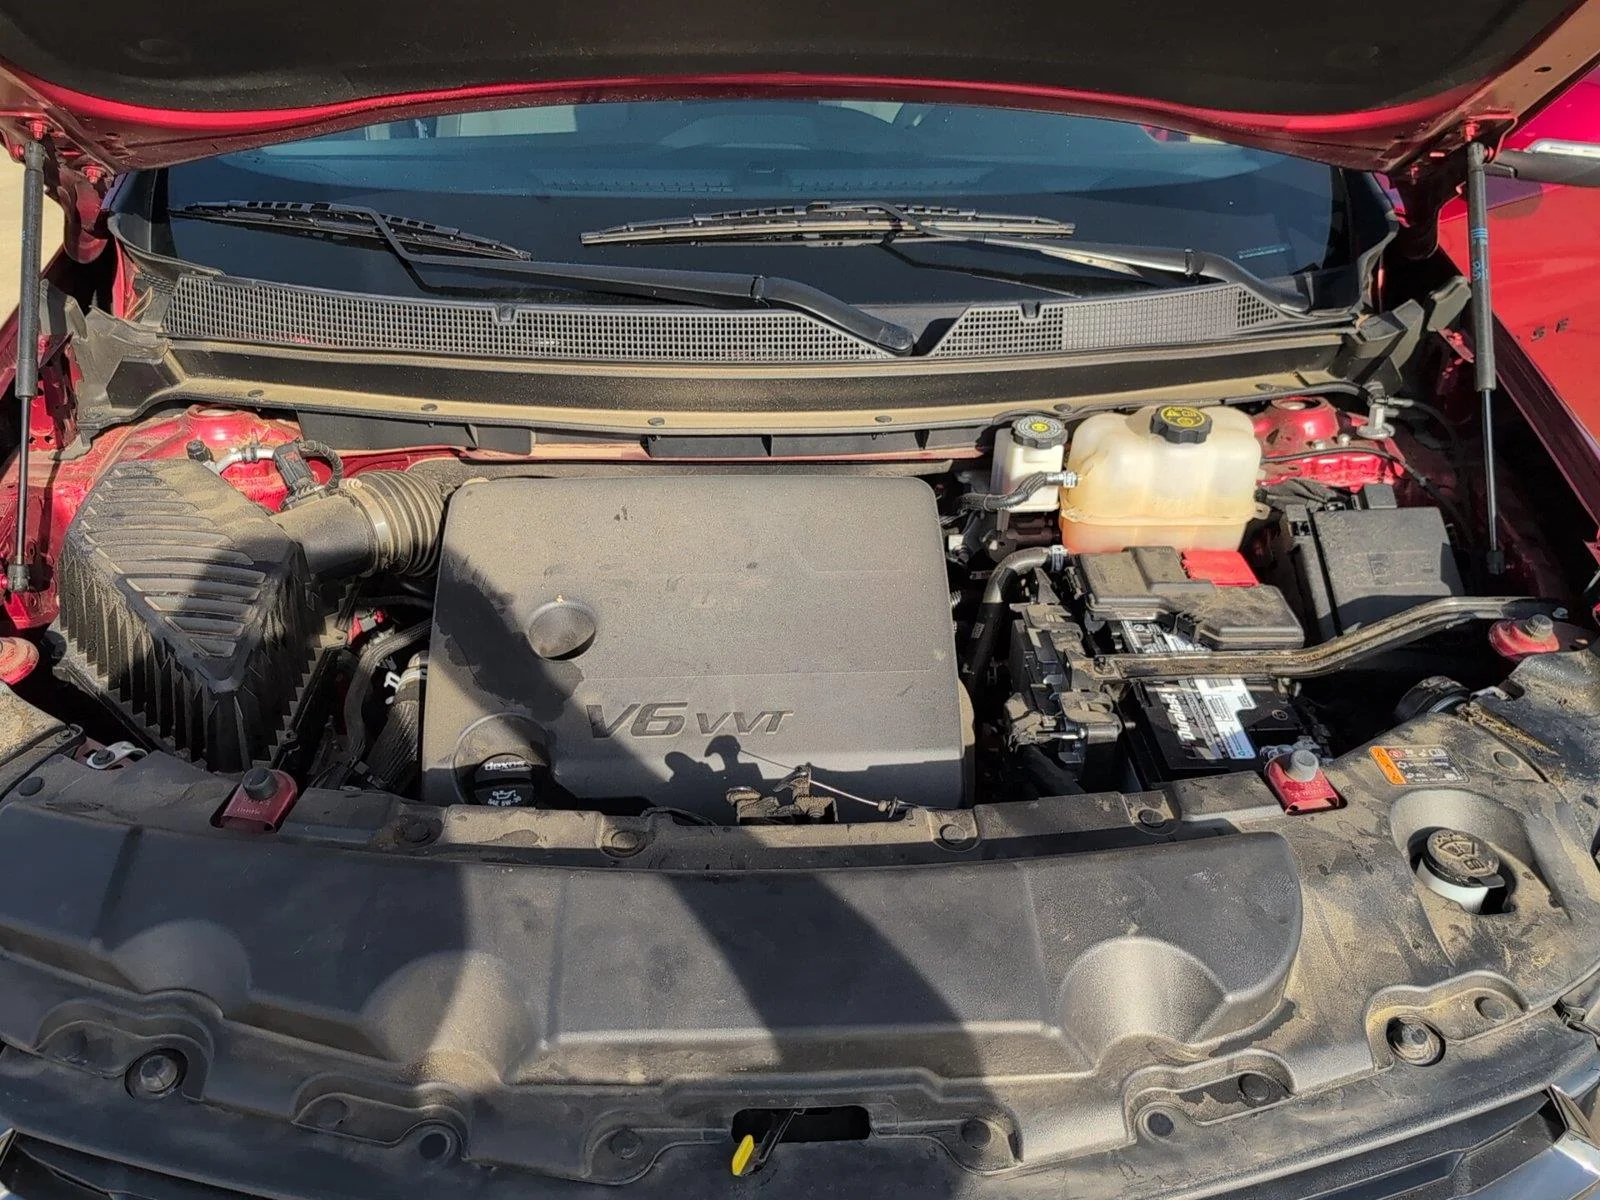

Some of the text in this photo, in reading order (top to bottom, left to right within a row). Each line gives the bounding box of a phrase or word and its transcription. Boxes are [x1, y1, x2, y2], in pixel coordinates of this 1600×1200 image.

[586, 702, 793, 738] V6 VVT
[1159, 693, 1197, 741] Duralast
